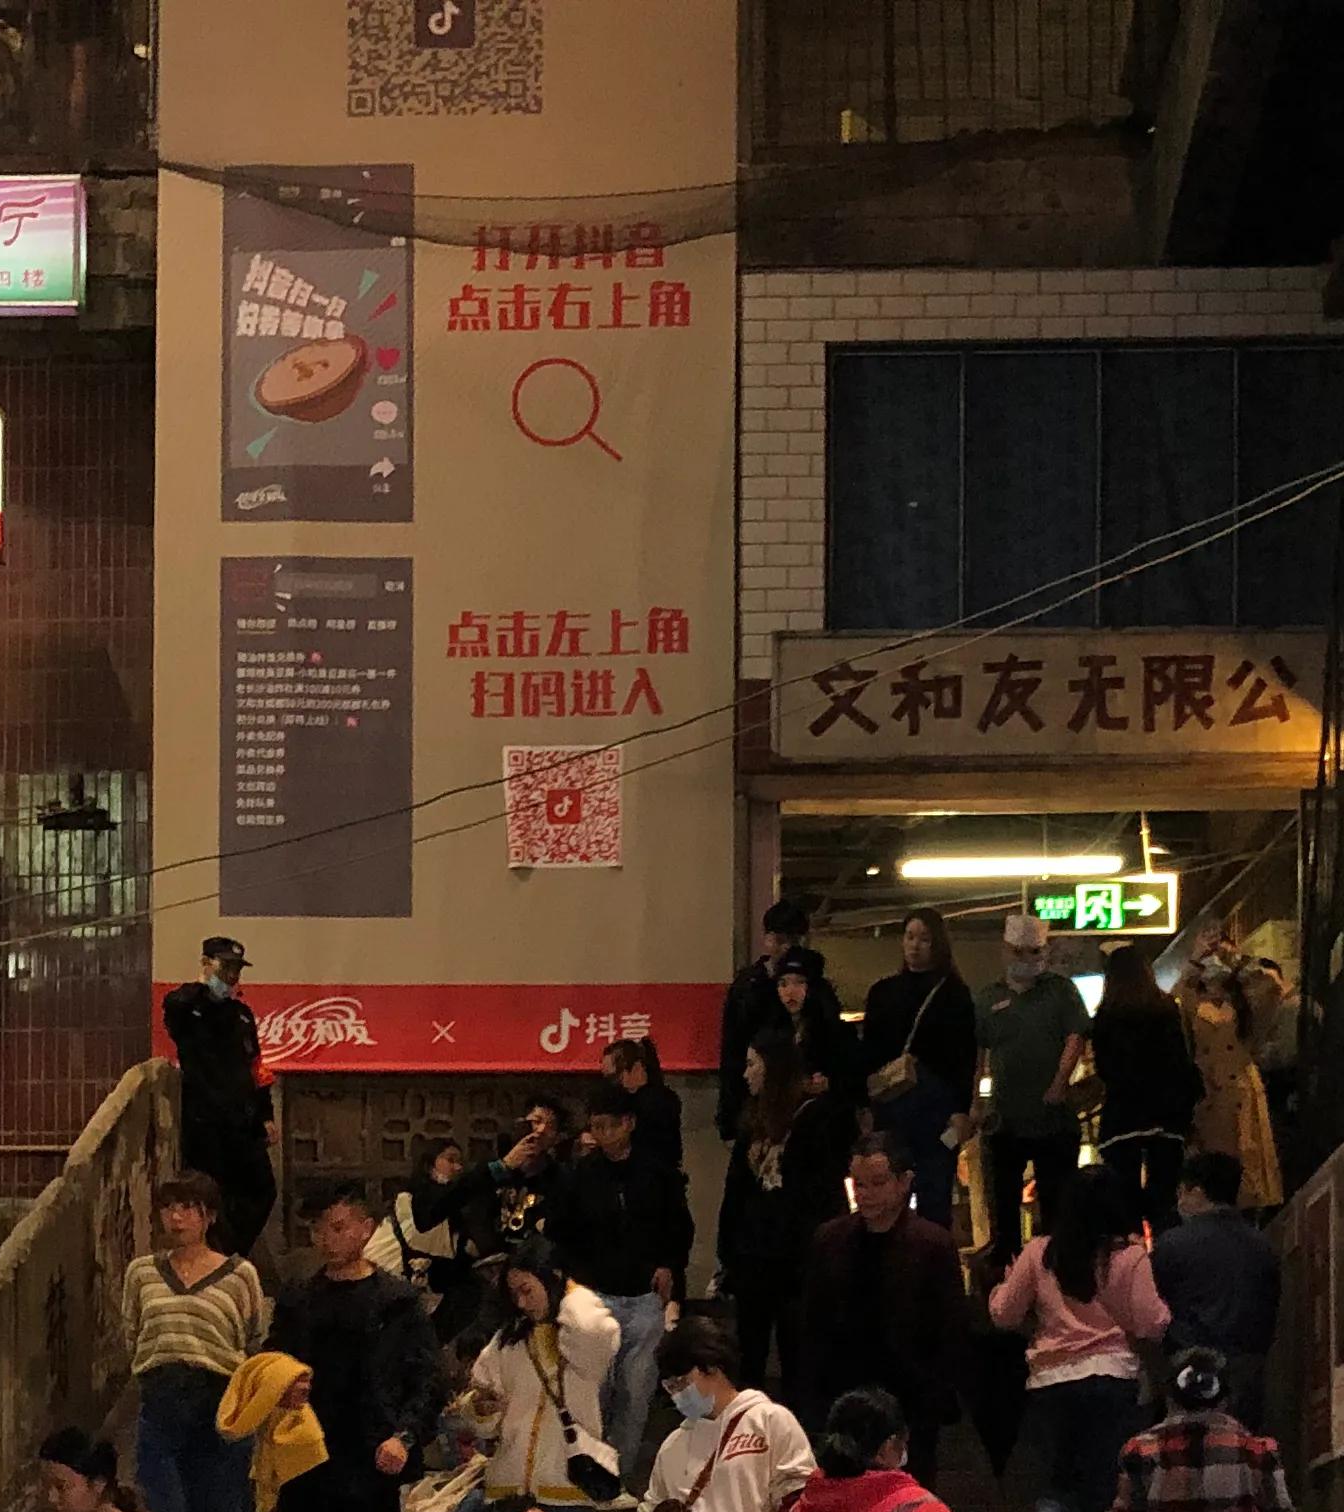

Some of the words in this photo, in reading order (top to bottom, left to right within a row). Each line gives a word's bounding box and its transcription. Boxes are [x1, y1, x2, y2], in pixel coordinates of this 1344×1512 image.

[472, 222, 666, 272] 打开抖音
[446, 281, 692, 332] 点击右上角
[446, 607, 691, 659] 点击左上角
[471, 667, 664, 718] 扫码进入
[809, 652, 1298, 738] 文和友无限公
[585, 1012, 653, 1045] 抖音
